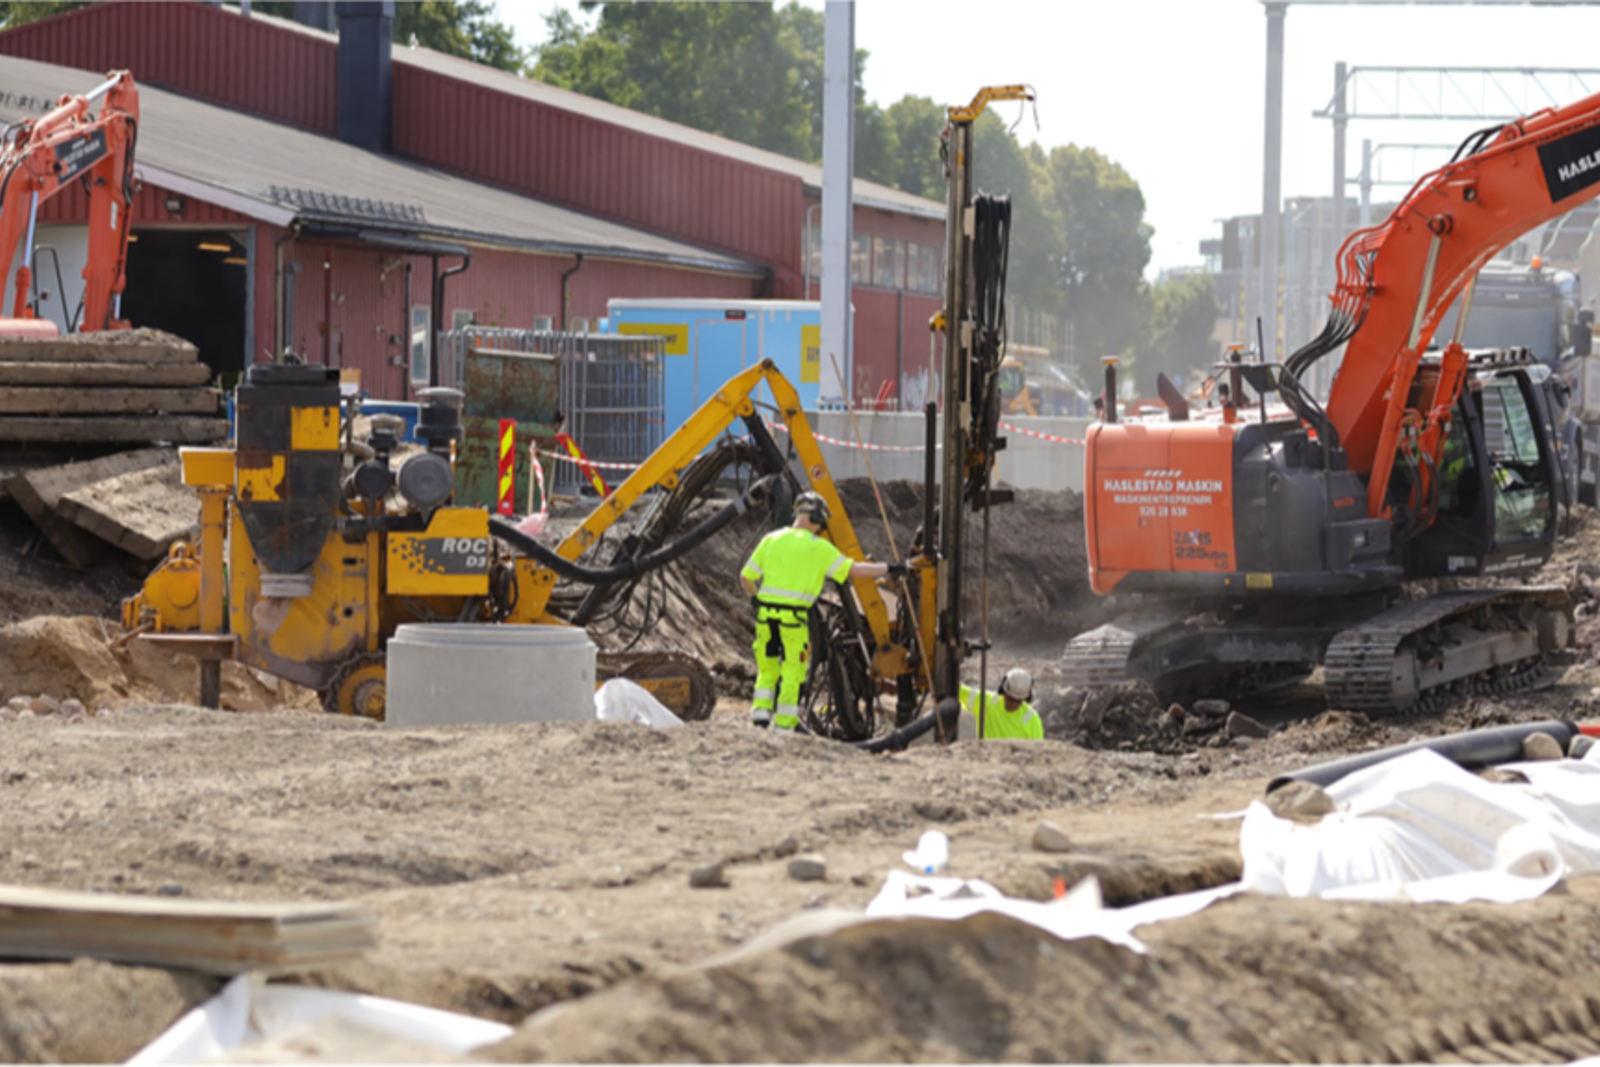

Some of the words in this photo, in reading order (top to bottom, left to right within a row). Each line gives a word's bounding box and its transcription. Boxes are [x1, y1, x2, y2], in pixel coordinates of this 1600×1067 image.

[1103, 479, 1174, 492] HASLESTAD
[1176, 479, 1223, 493] MASKIN
[1174, 529, 1212, 545] ZAXIS
[442, 538, 487, 553] ROC
[466, 556, 486, 567] D3
